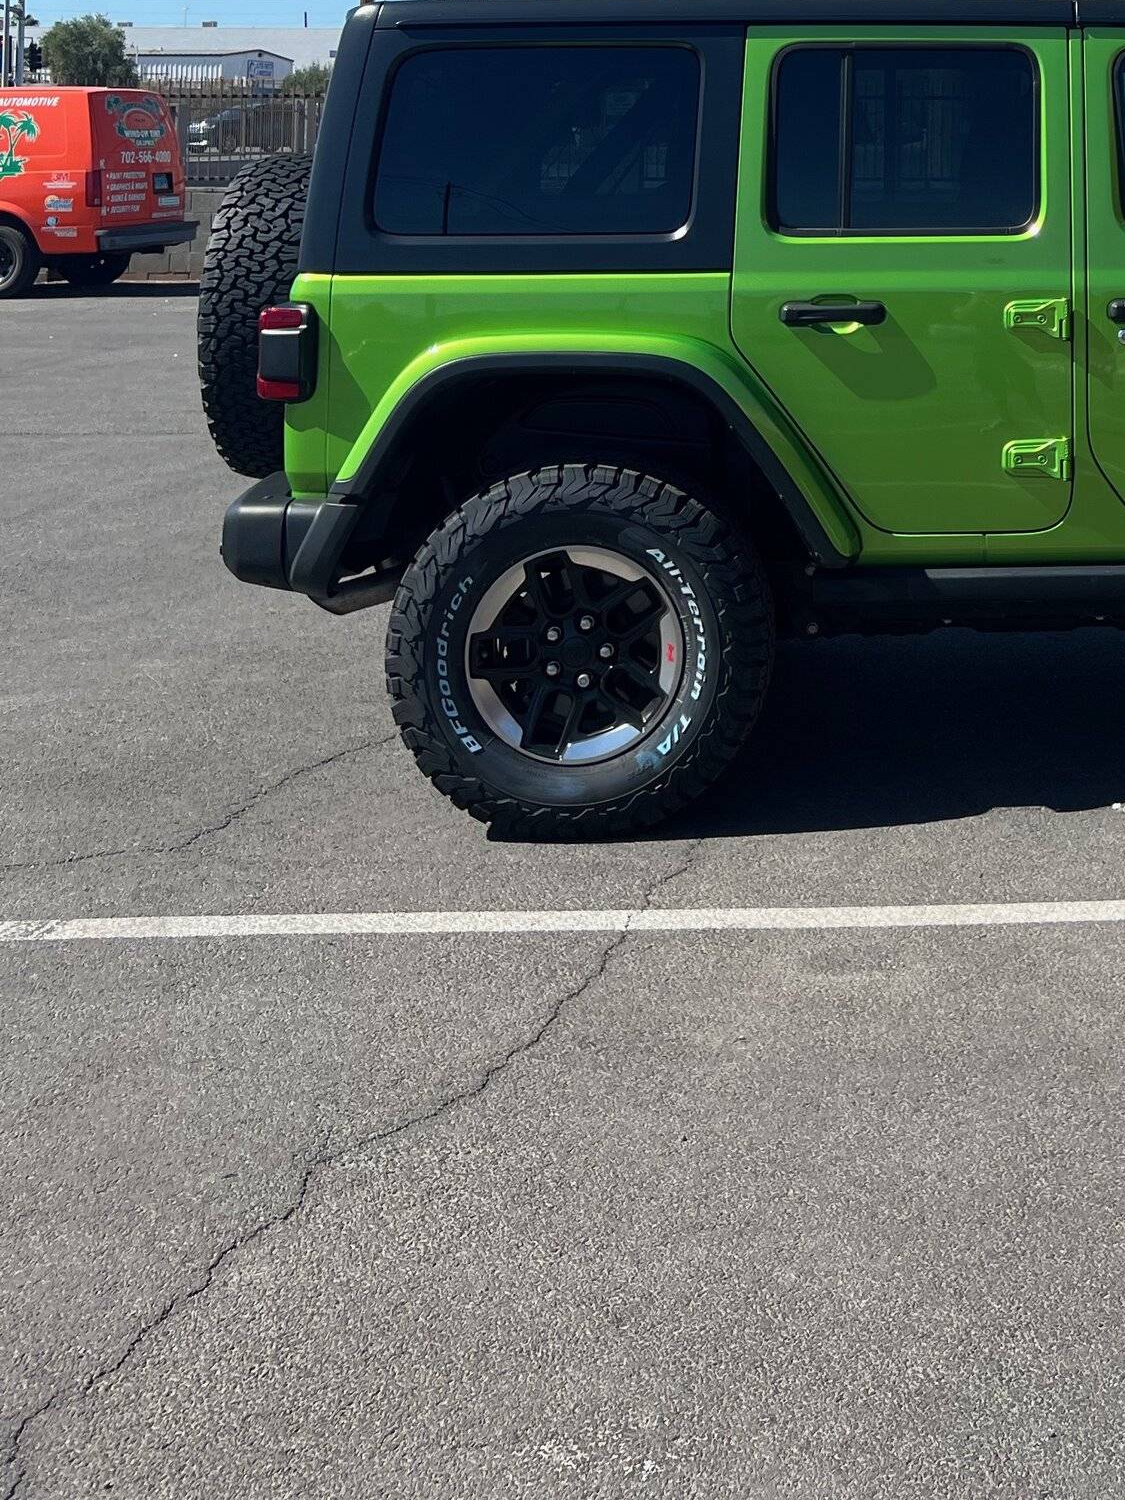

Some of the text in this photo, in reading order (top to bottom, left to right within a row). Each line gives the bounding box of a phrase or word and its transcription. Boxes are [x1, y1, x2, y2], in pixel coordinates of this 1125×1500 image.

[436, 576, 484, 753] BFGoodrich
[646, 548, 706, 755] All-Terrain T/A
